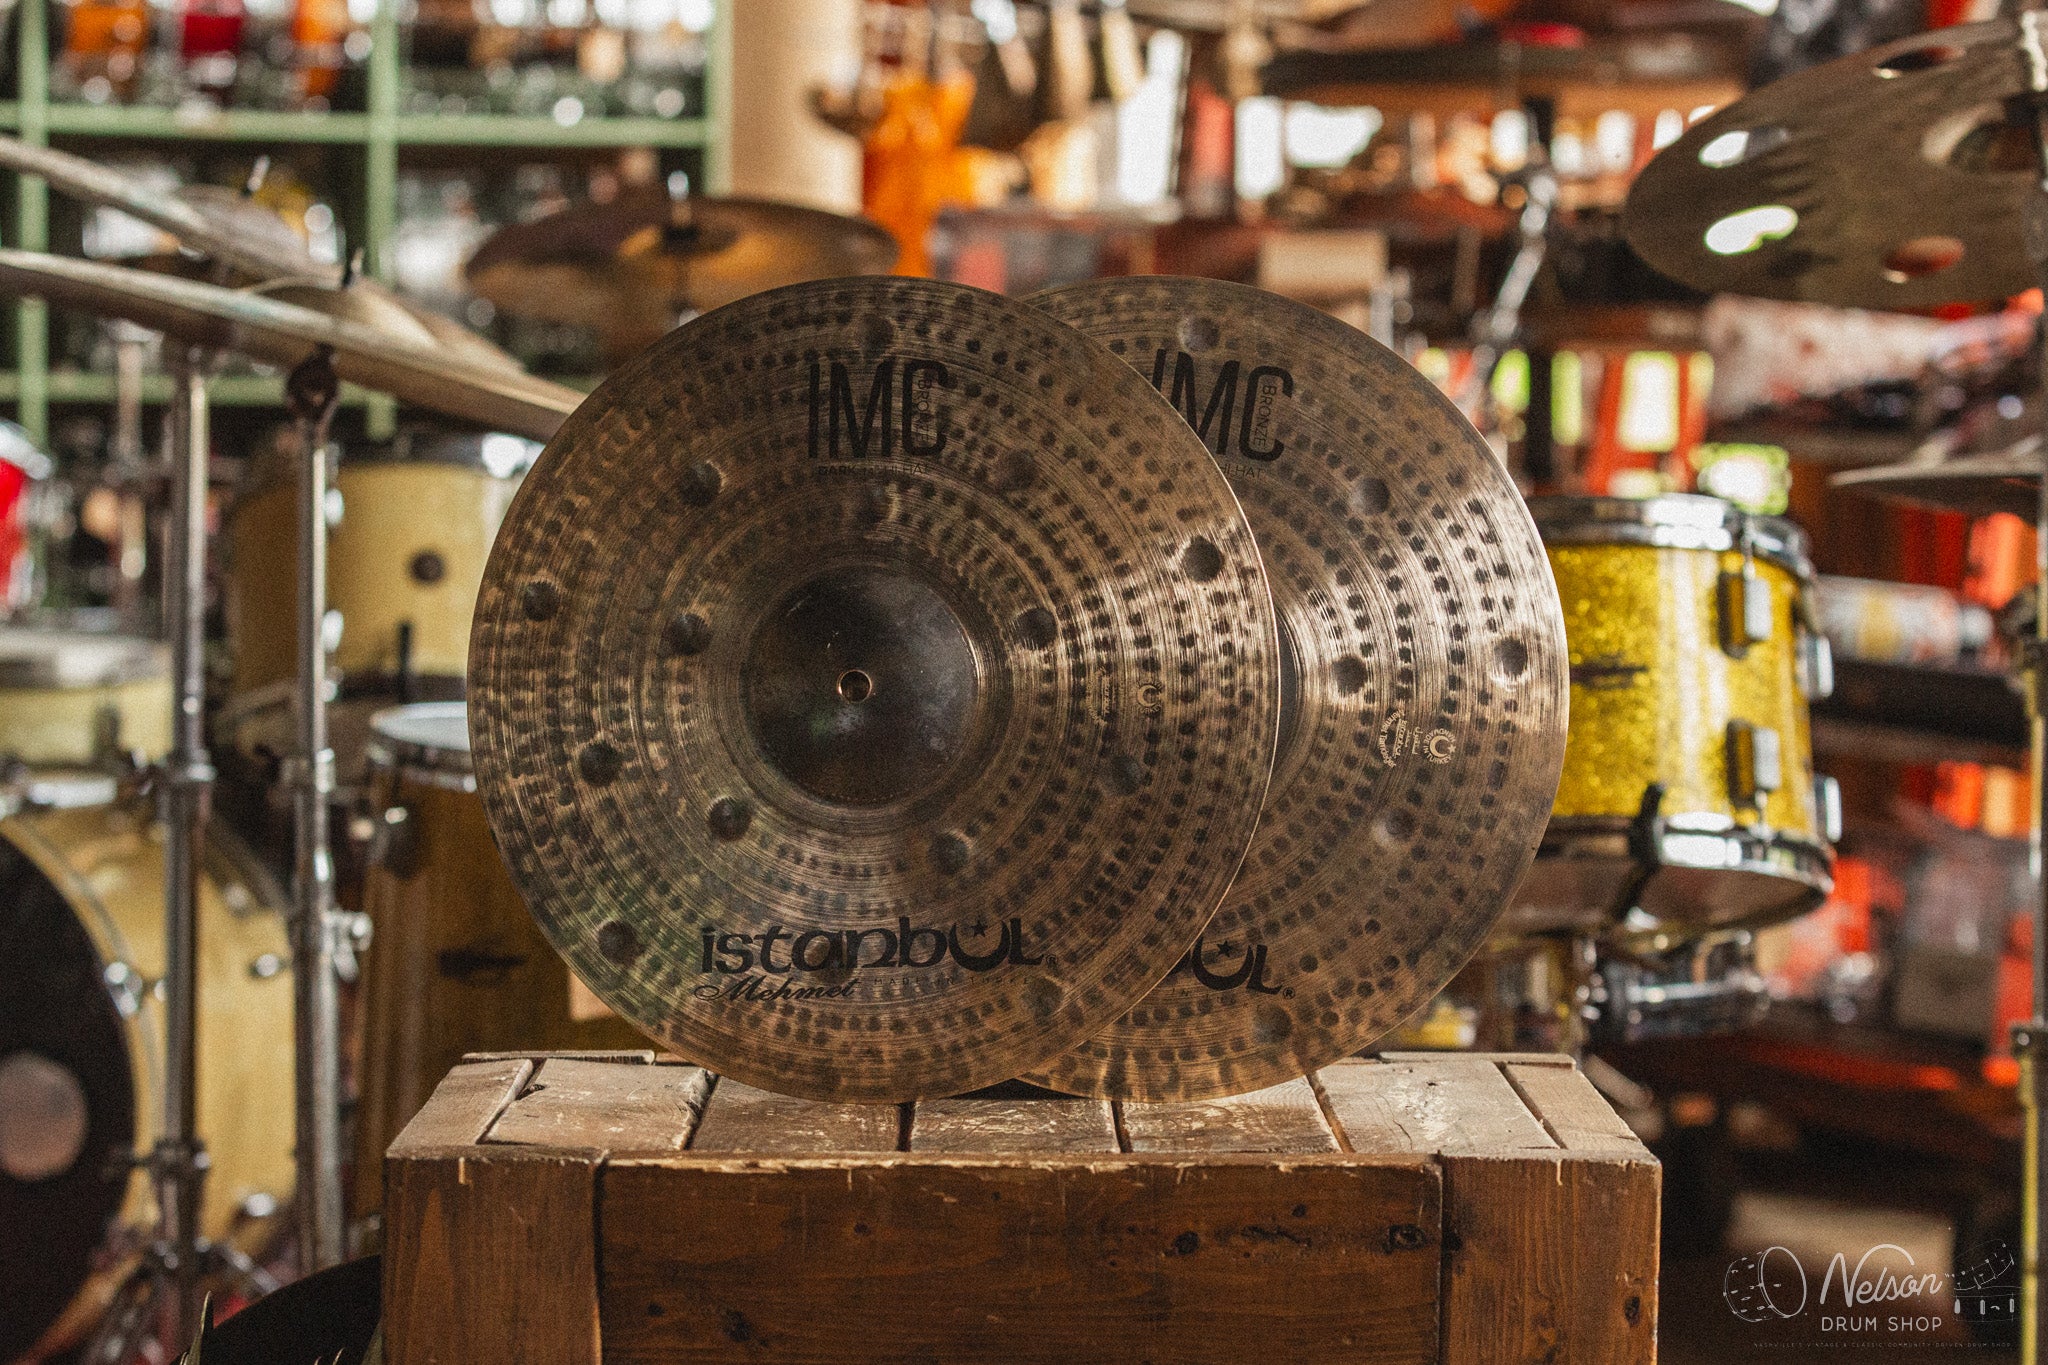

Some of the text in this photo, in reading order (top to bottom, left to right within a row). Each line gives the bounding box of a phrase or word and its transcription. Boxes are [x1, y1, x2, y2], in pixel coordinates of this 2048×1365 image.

[808, 357, 950, 458] IMC
[918, 378, 933, 447] BRONZE
[1252, 384, 1277, 447] BRONZE
[694, 975, 858, 1002] Mehmet
